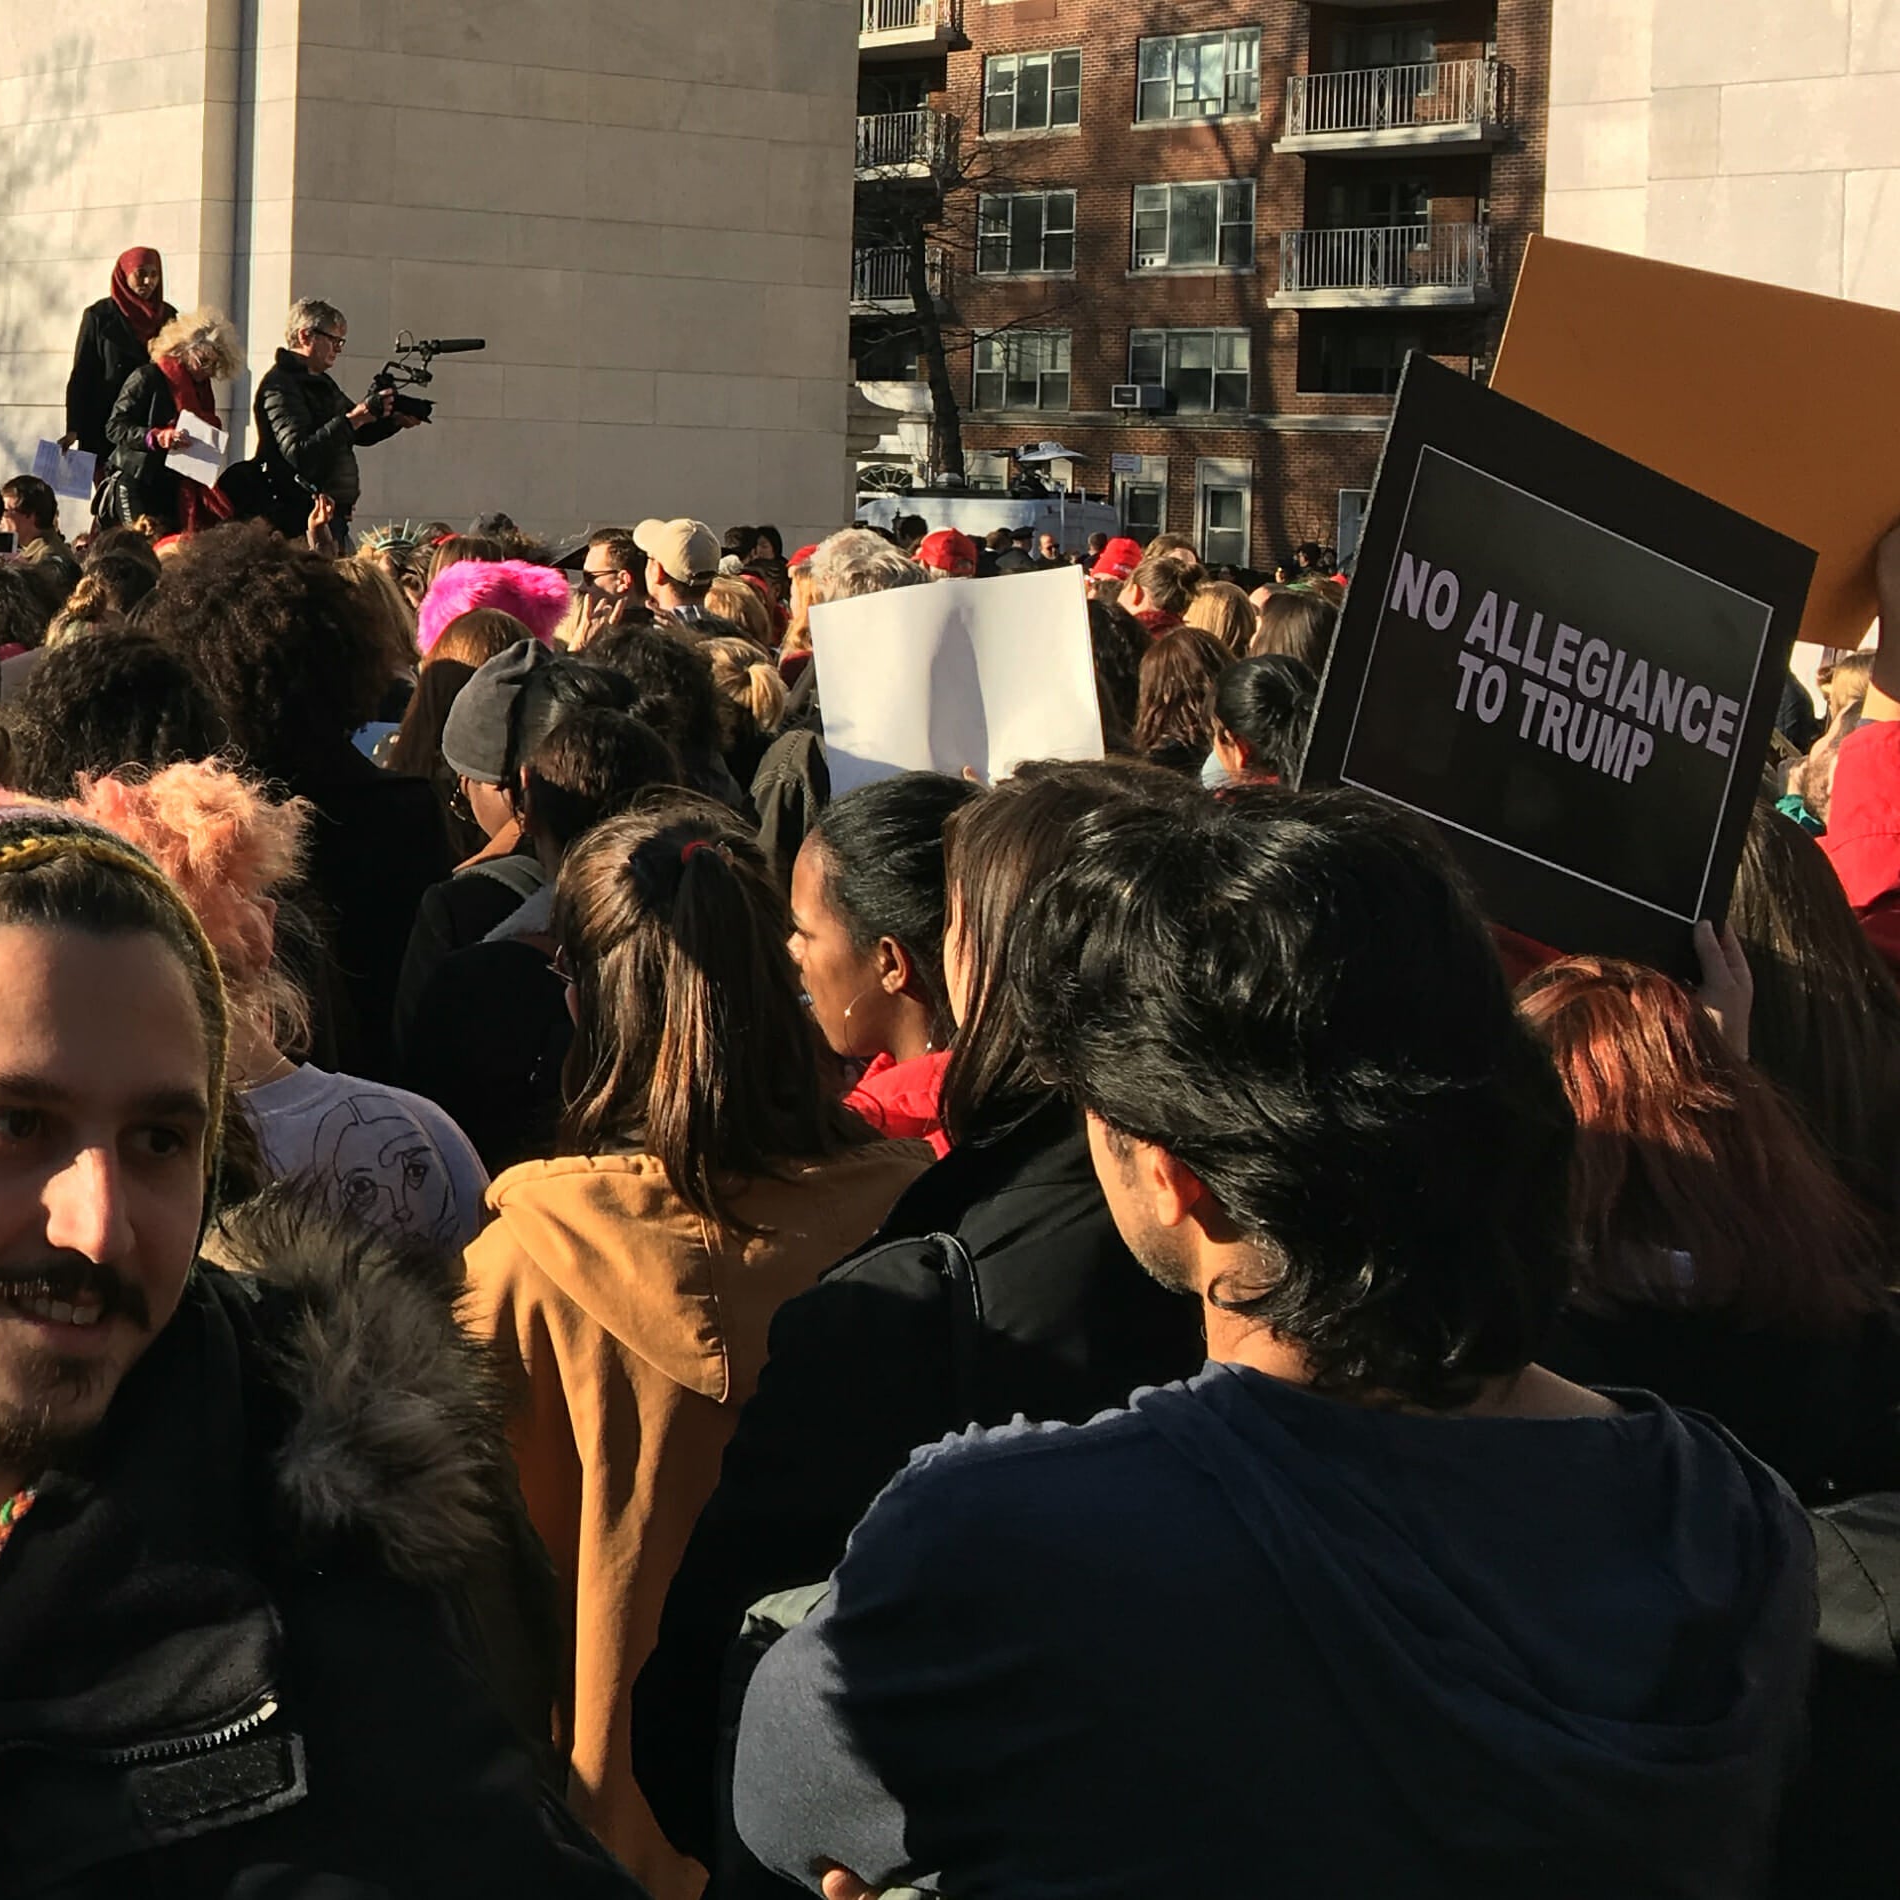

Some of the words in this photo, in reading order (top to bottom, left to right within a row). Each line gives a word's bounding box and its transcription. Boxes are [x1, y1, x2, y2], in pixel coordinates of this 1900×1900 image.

[1391, 552, 1459, 630] NO
[1464, 590, 1742, 759] ALLEGIANCE
[1454, 650, 1506, 725] TO
[1518, 680, 1656, 785] TRUMP
